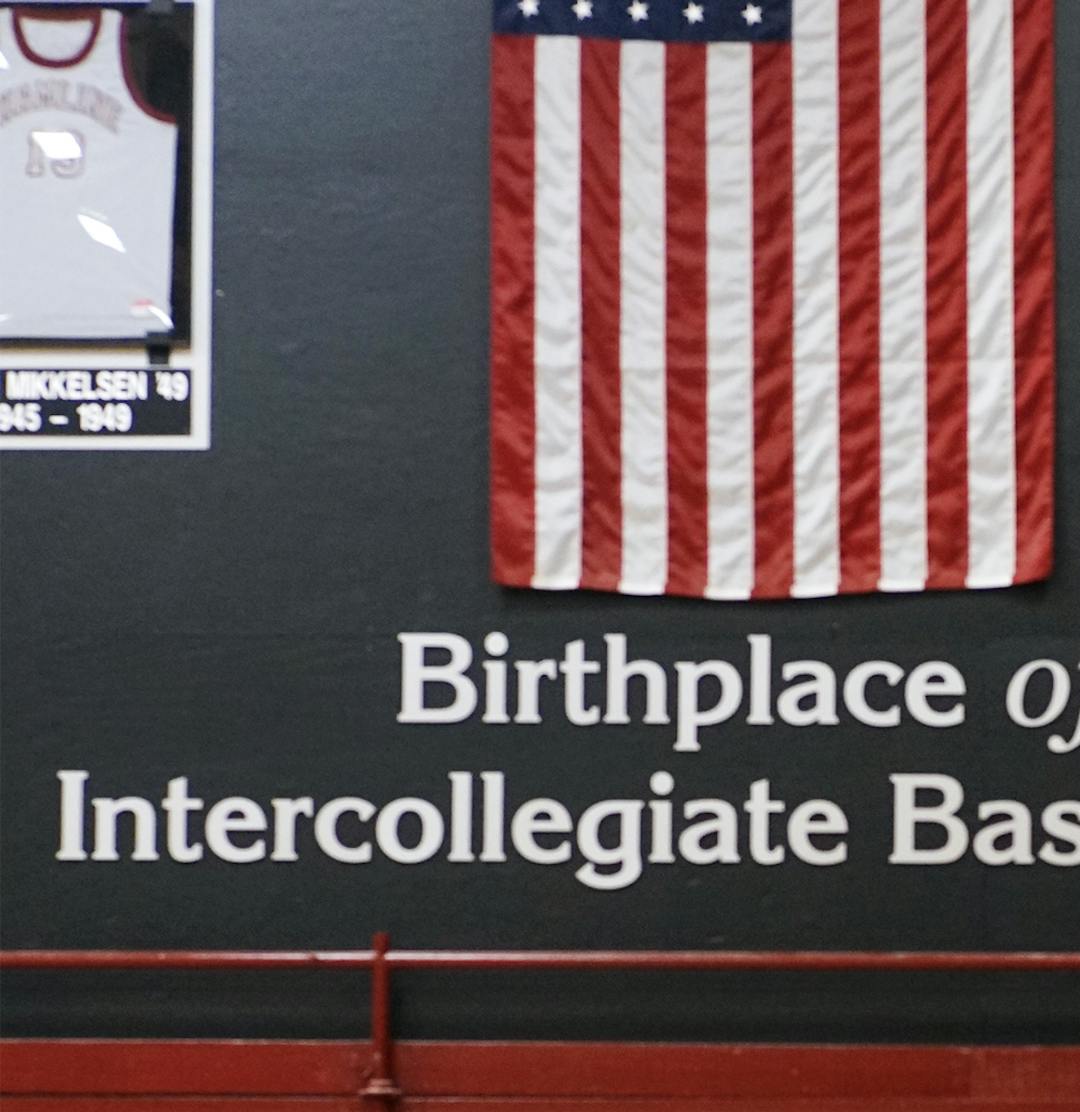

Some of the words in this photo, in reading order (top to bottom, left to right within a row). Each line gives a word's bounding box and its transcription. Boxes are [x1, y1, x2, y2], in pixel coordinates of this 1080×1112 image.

[6, 371, 148, 401] MIKKELSEN
[155, 371, 189, 401] '49
[76, 402, 133, 432] 1949
[397, 632, 966, 752] Birthplace
[56, 770, 849, 890] Intercollegiate
